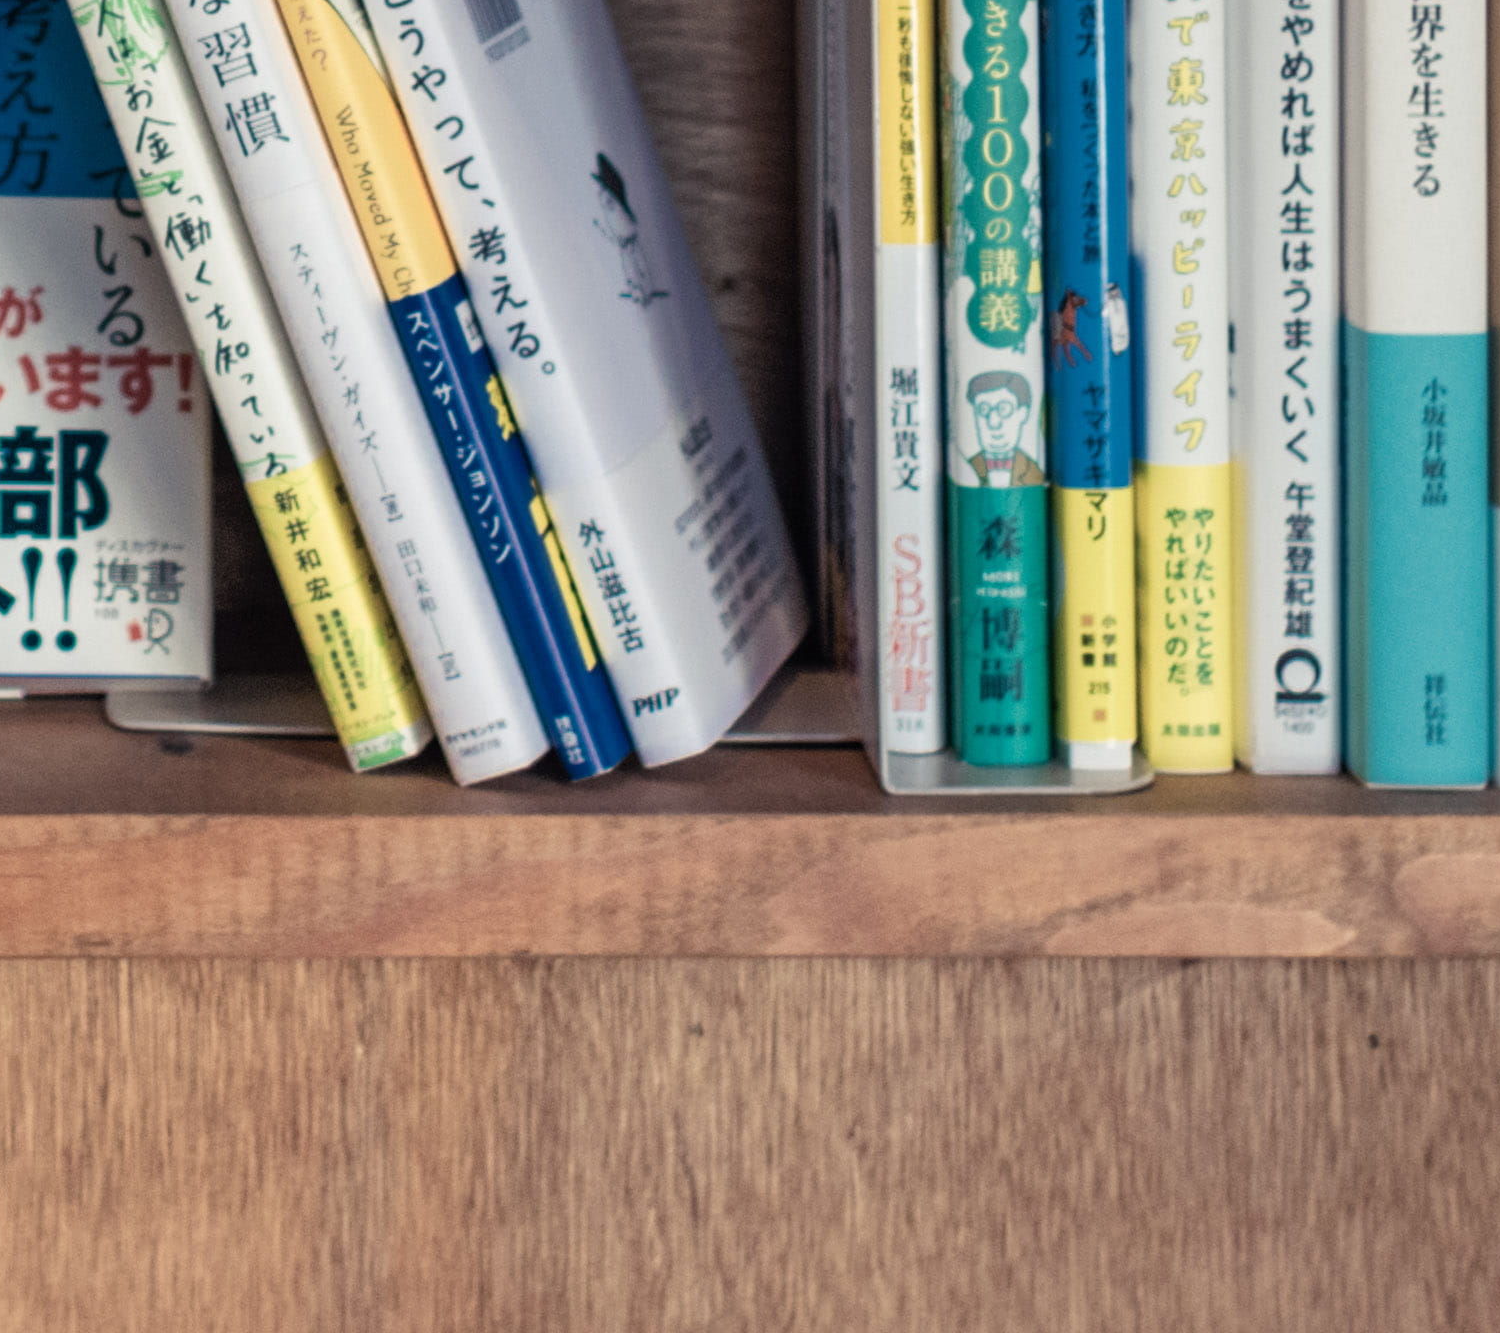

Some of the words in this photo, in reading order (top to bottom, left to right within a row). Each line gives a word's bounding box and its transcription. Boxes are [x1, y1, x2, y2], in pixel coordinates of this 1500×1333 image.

[335, 104, 362, 156] Who
[353, 160, 390, 227] Moved
[379, 231, 403, 262] My
[289, 240, 379, 453] スティーヴン・ガイズ
[406, 310, 511, 564] スペンサー・ジョンソン
[890, 366, 921, 492] 堀江貴文
[92, 557, 186, 604] 携書
[273, 487, 334, 604] 新井和宏
[577, 517, 646, 655] 外山滋比古
[977, 515, 1024, 561] 森
[1164, 506, 1192, 697] やればいいのだ。
[1192, 506, 1216, 686] やりたいことを
[1283, 480, 1317, 639] 午堂登紀雄
[888, 533, 932, 714] SB新書
[978, 605, 1025, 703] 博嗣
[630, 687, 681, 718] PHP
[1423, 672, 1447, 746] 祥伝社
